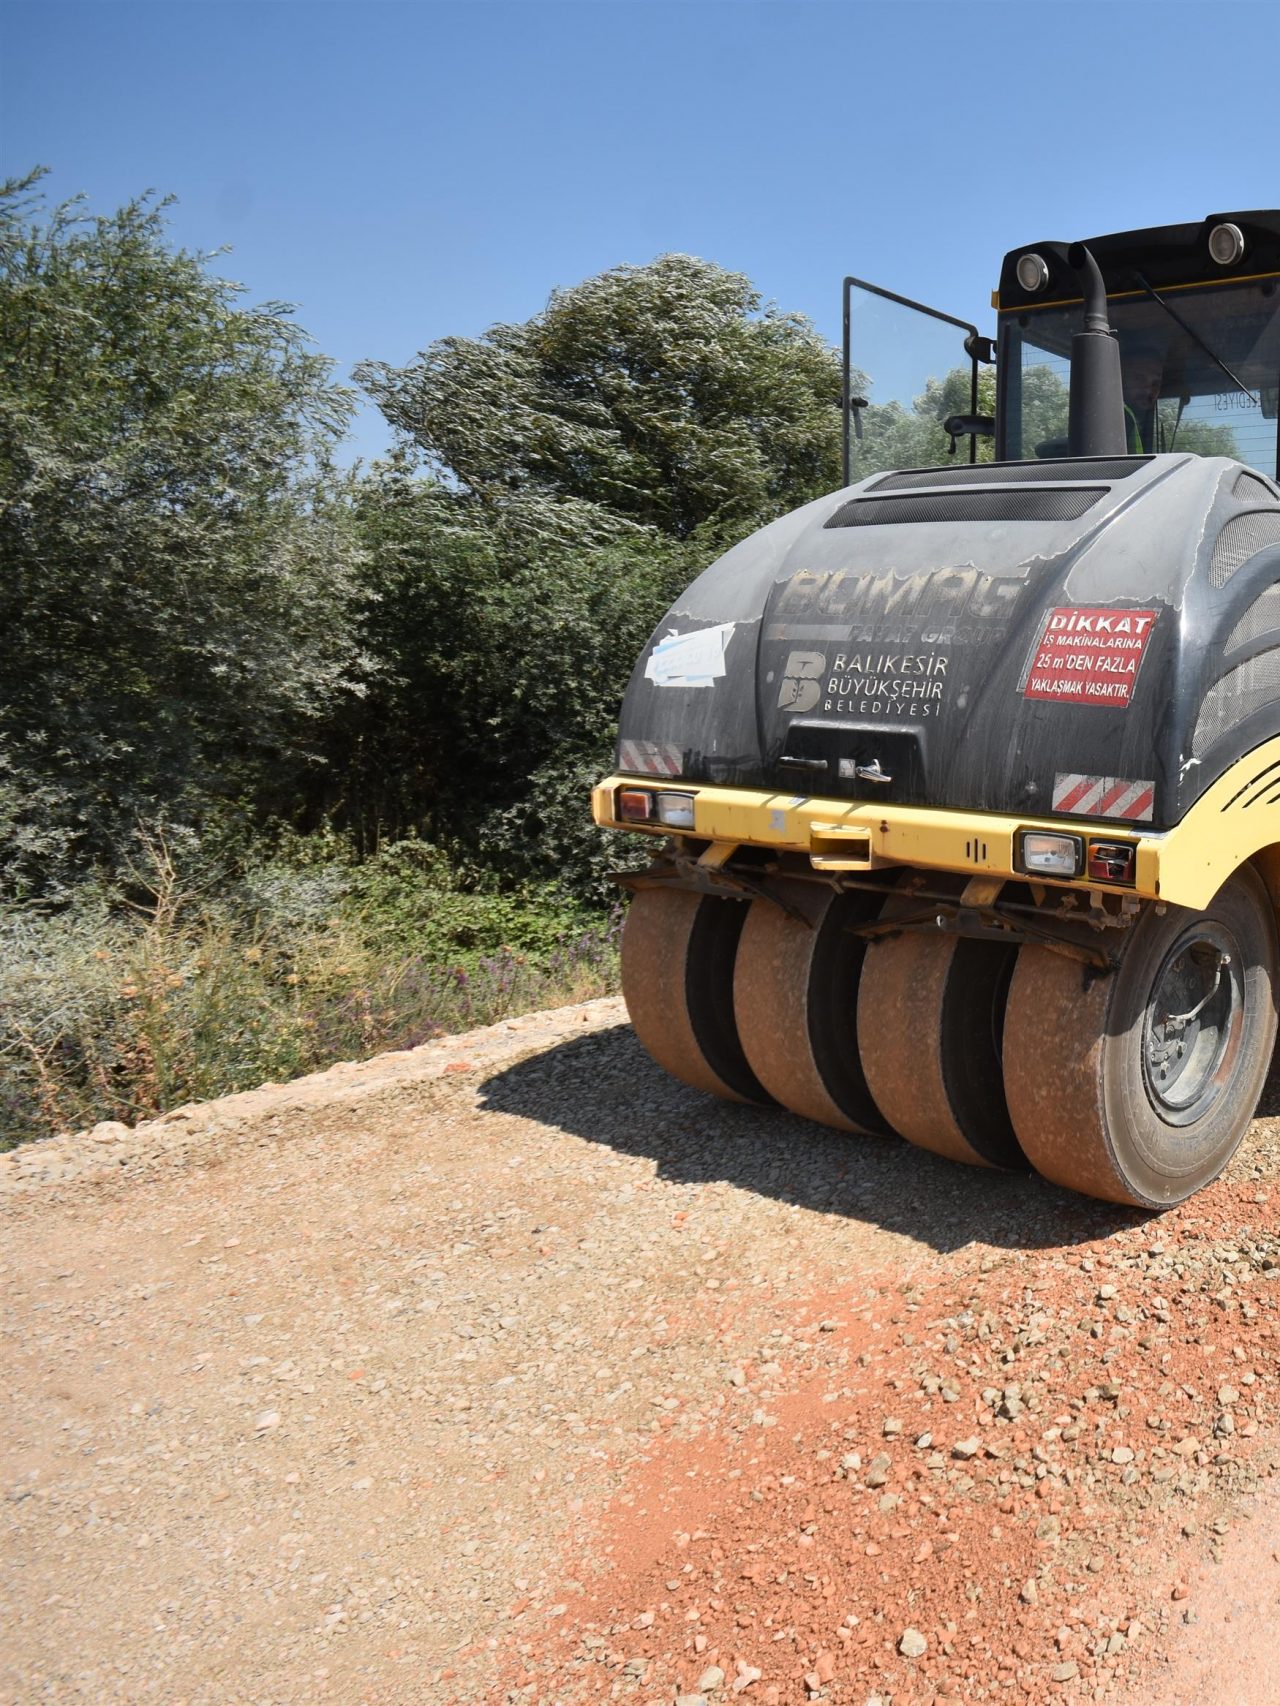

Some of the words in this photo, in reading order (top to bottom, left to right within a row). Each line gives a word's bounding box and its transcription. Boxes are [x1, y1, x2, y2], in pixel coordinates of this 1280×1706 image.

[1050, 611, 1151, 633] DİKKAT
[1056, 634, 1142, 649] MAKİNALARINA
[833, 652, 948, 676] BALIKESİR
[1037, 654, 1052, 668] 25
[1095, 656, 1135, 673] FAZLA
[827, 675, 943, 701] BÜYÜKŞEHİR
[1031, 678, 1083, 695] YAKLAŞMAK
[824, 699, 941, 716] BELEDİYESİ
